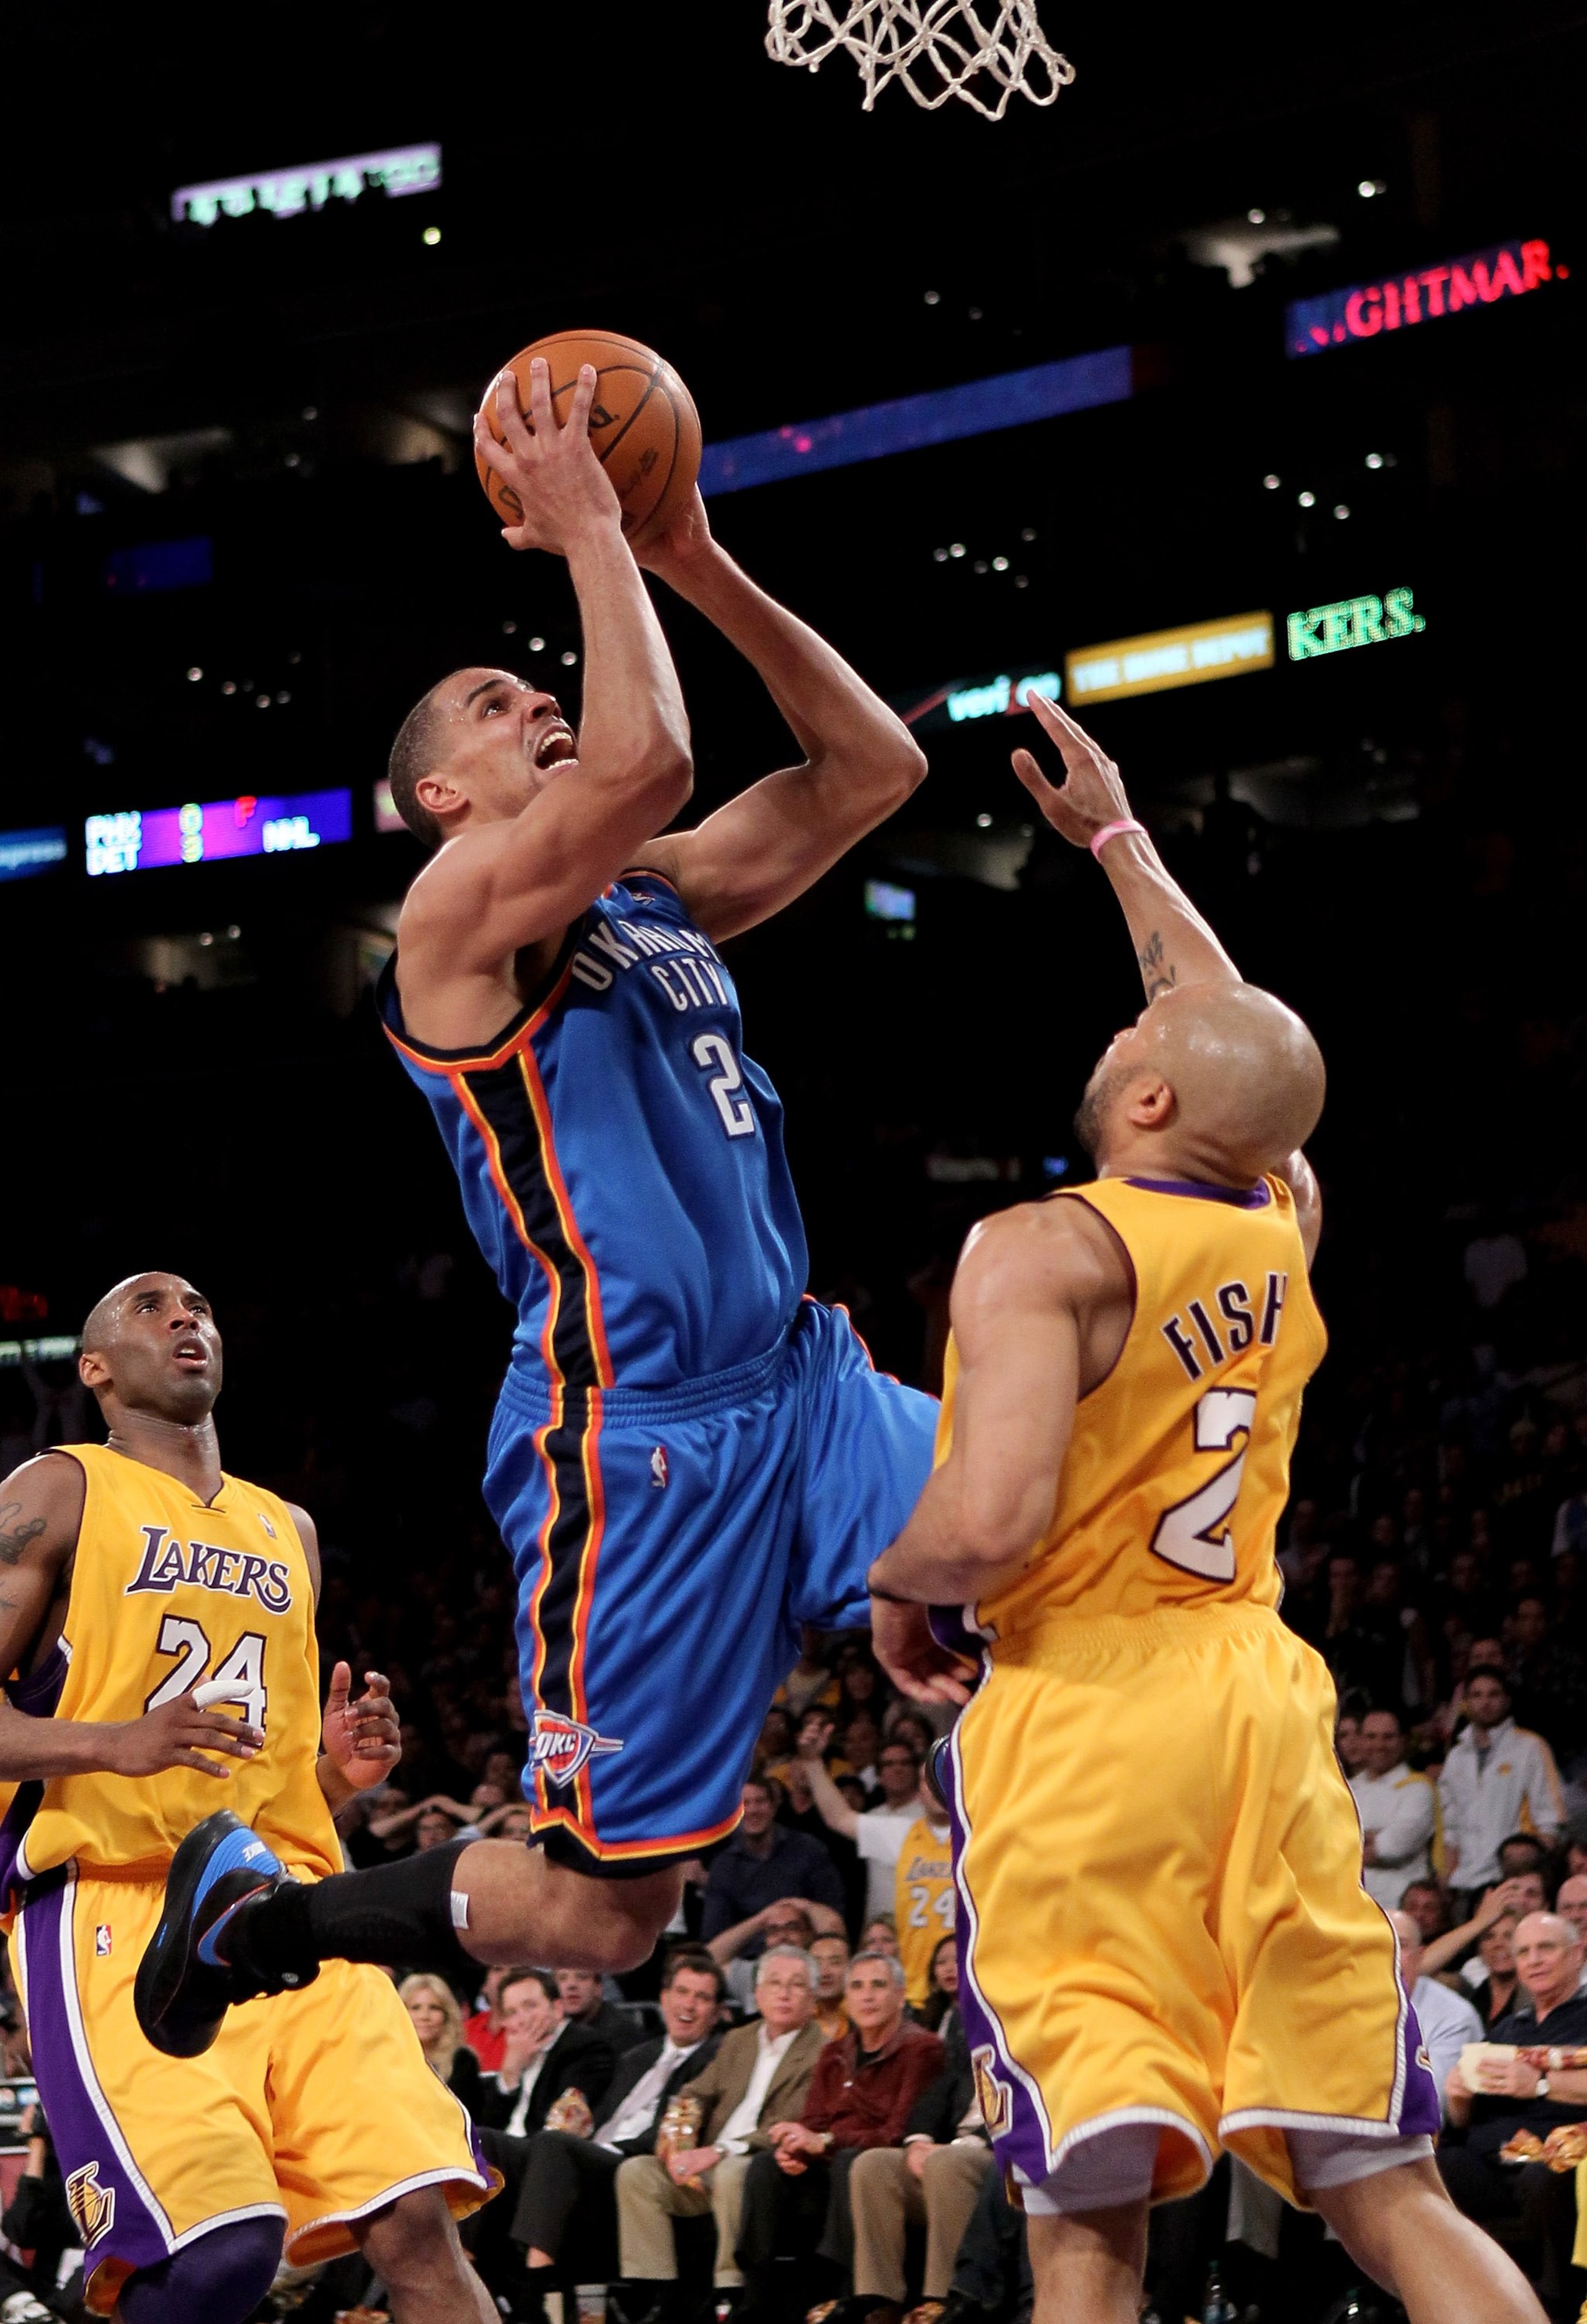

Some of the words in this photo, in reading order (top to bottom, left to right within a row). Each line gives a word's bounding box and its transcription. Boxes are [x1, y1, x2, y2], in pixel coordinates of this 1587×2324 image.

[234, 795, 258, 828] F
[651, 958, 728, 1011] CITY
[690, 1031, 756, 1139] 2
[1149, 1386, 1258, 1583] 2
[124, 1525, 292, 1615] LAKERS
[144, 1614, 268, 1749] 24
[534, 1731, 577, 1760] OKC
[909, 1886, 956, 1929] 24
